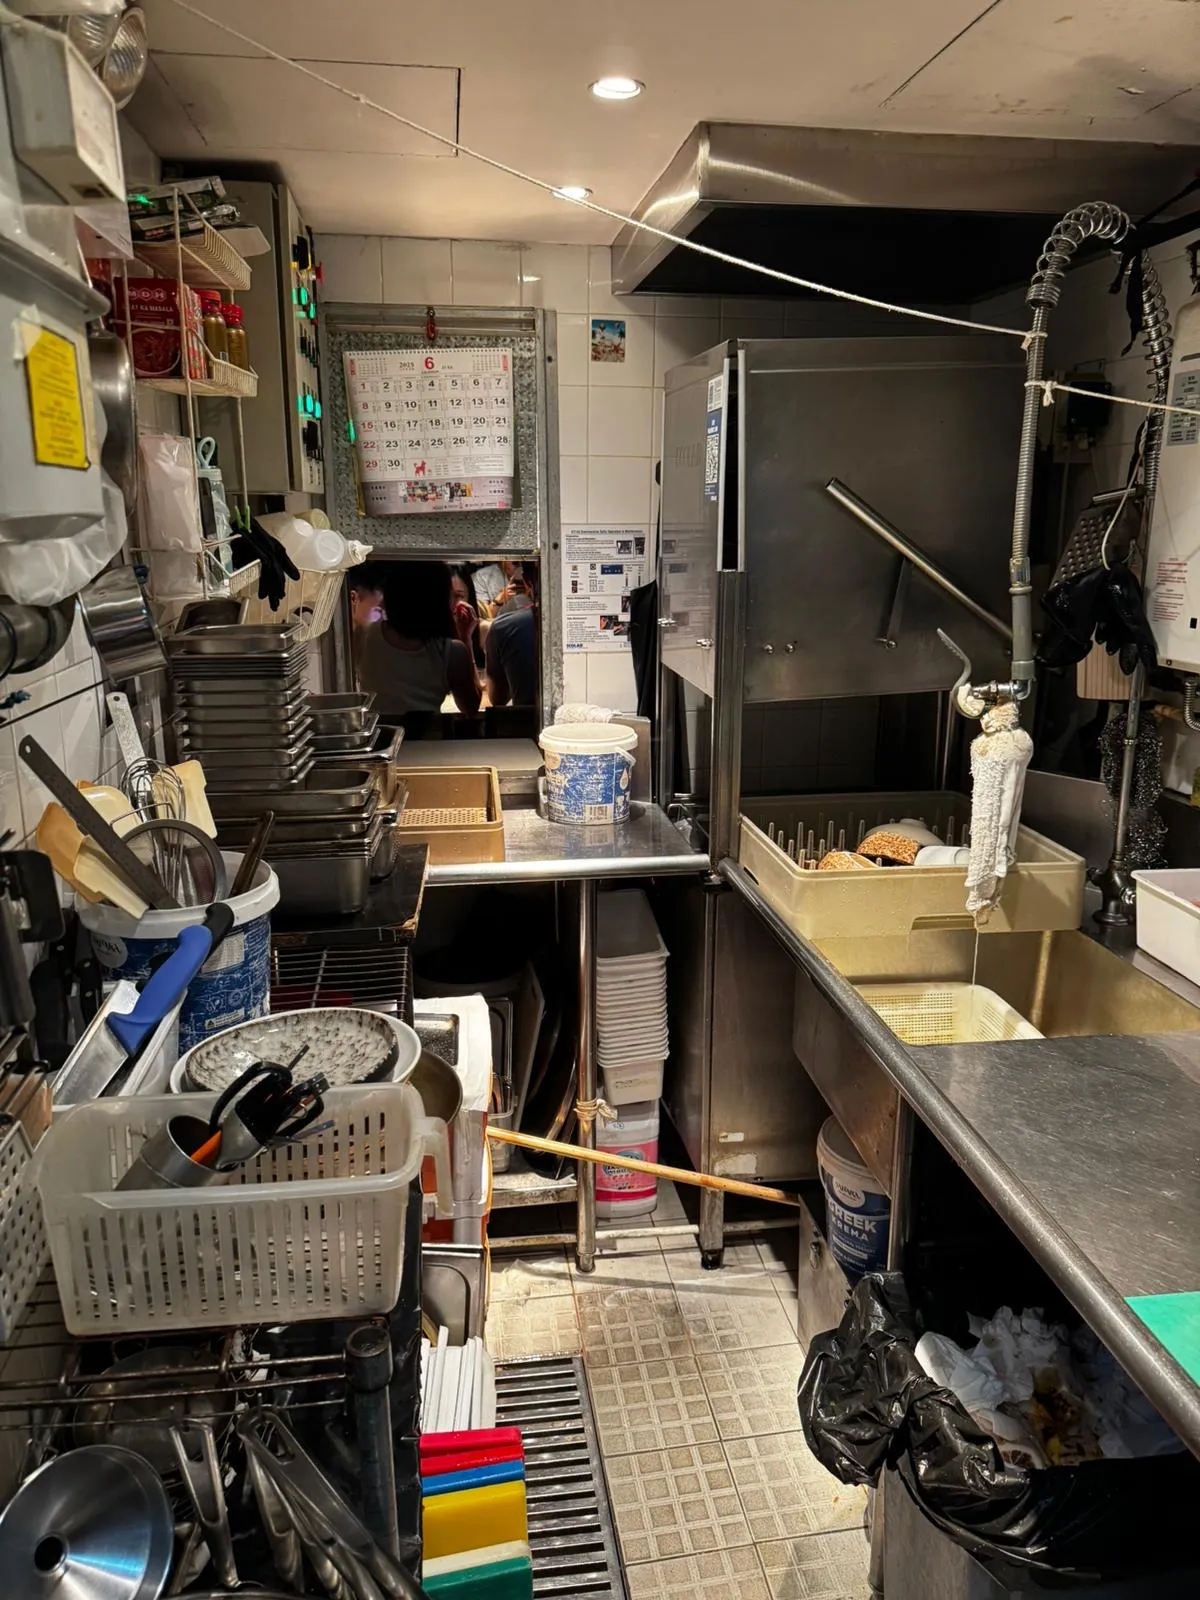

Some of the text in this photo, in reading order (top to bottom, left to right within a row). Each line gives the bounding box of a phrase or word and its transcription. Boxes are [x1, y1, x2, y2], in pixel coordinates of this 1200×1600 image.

[425, 357, 434, 369] 6
[828, 1200, 876, 1233] GREEK
[832, 1217, 868, 1240] KREMA
